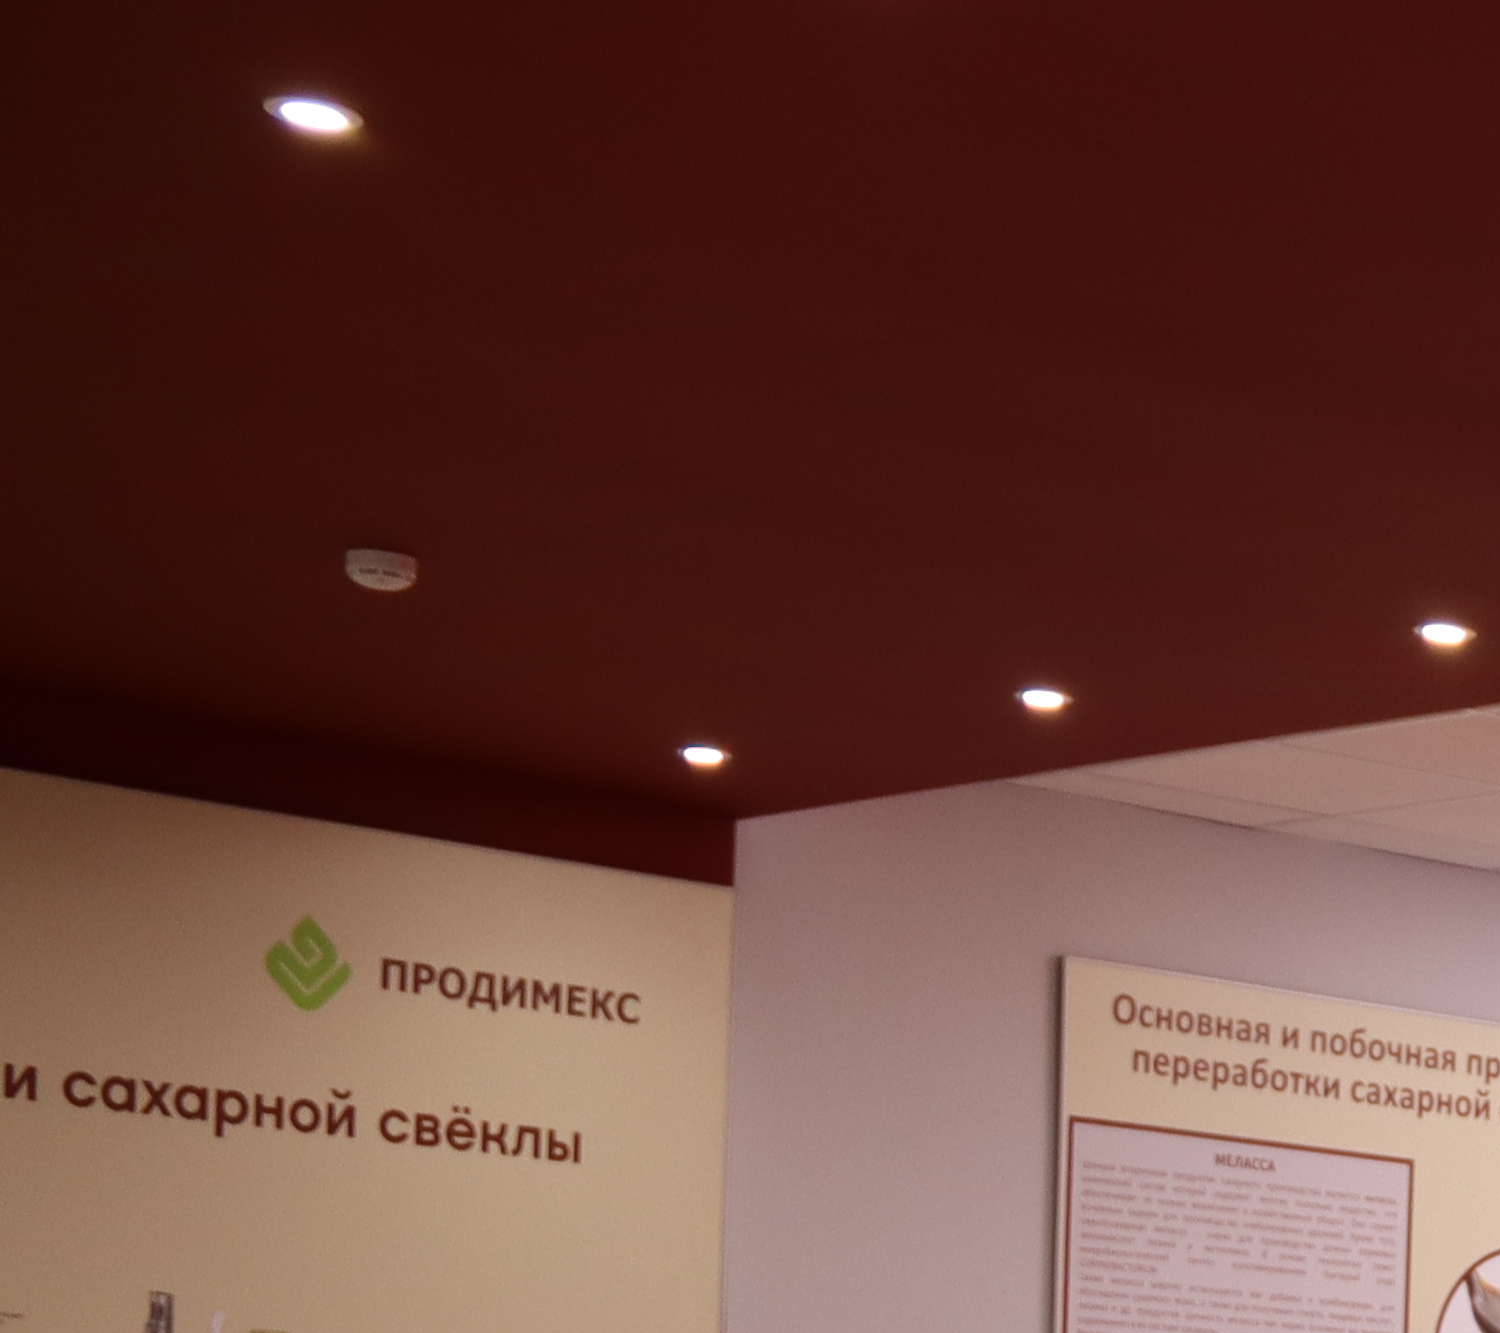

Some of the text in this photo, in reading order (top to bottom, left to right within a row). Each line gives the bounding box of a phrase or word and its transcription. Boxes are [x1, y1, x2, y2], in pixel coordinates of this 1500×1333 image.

[379, 956, 642, 1026] ПРОДИМЕКС
[1111, 993, 1271, 1046] Основная
[1280, 1026, 1300, 1050] и
[1309, 1027, 1457, 1073] побочная
[61, 1070, 358, 1140] сахарной
[377, 1104, 584, 1165] свёклы
[1131, 1048, 1342, 1101] переработки
[1349, 1080, 1492, 1122] сахарной
[1213, 1153, 1276, 1173] МЕЛАССА
